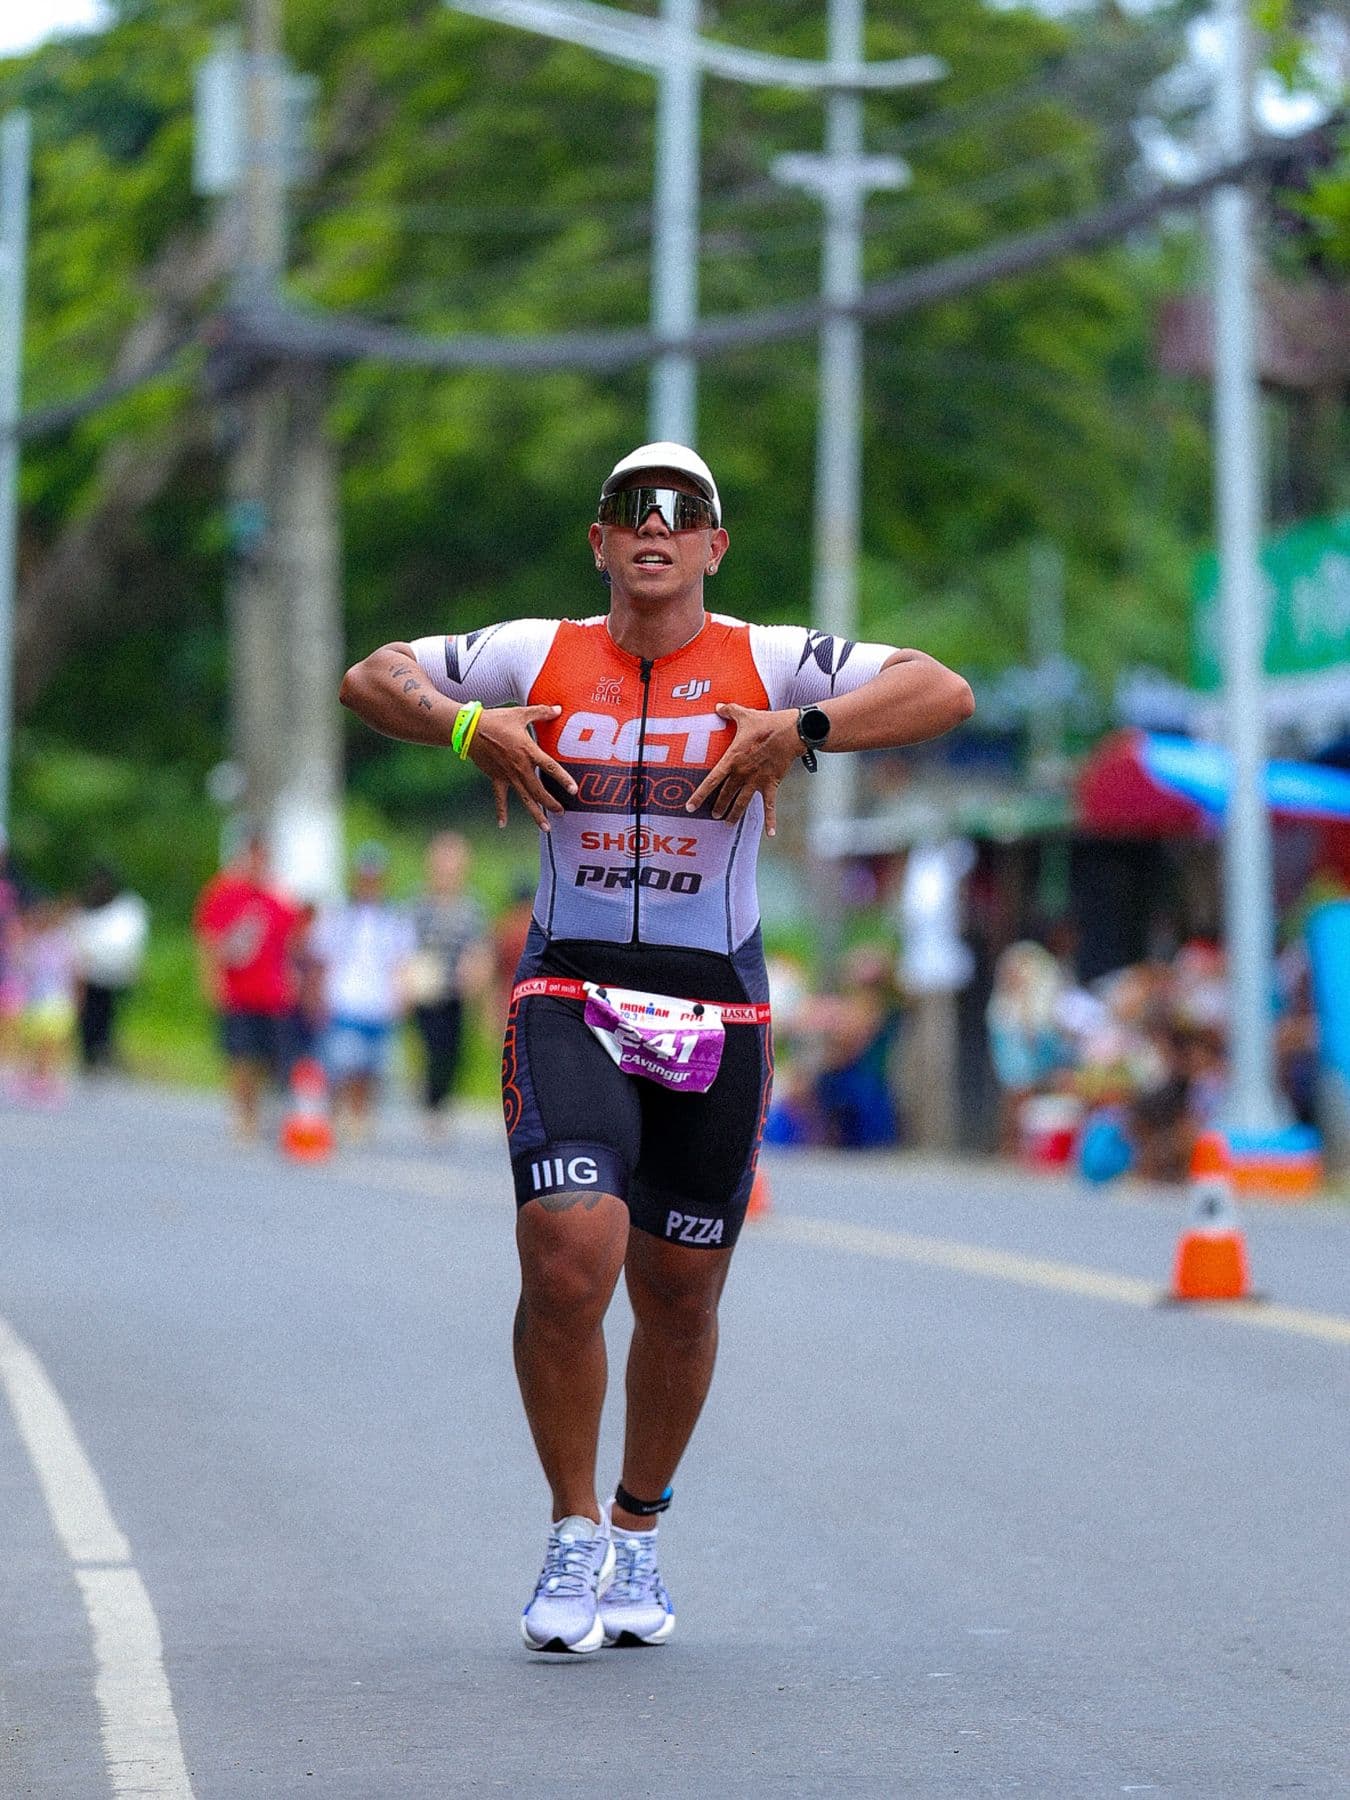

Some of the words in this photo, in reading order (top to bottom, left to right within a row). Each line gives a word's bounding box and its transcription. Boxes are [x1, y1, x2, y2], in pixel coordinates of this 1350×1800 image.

[580, 831, 698, 857] SHOKZ
[620, 1002, 670, 1018] IRONMAN
[665, 1210, 725, 1245] PZZA
